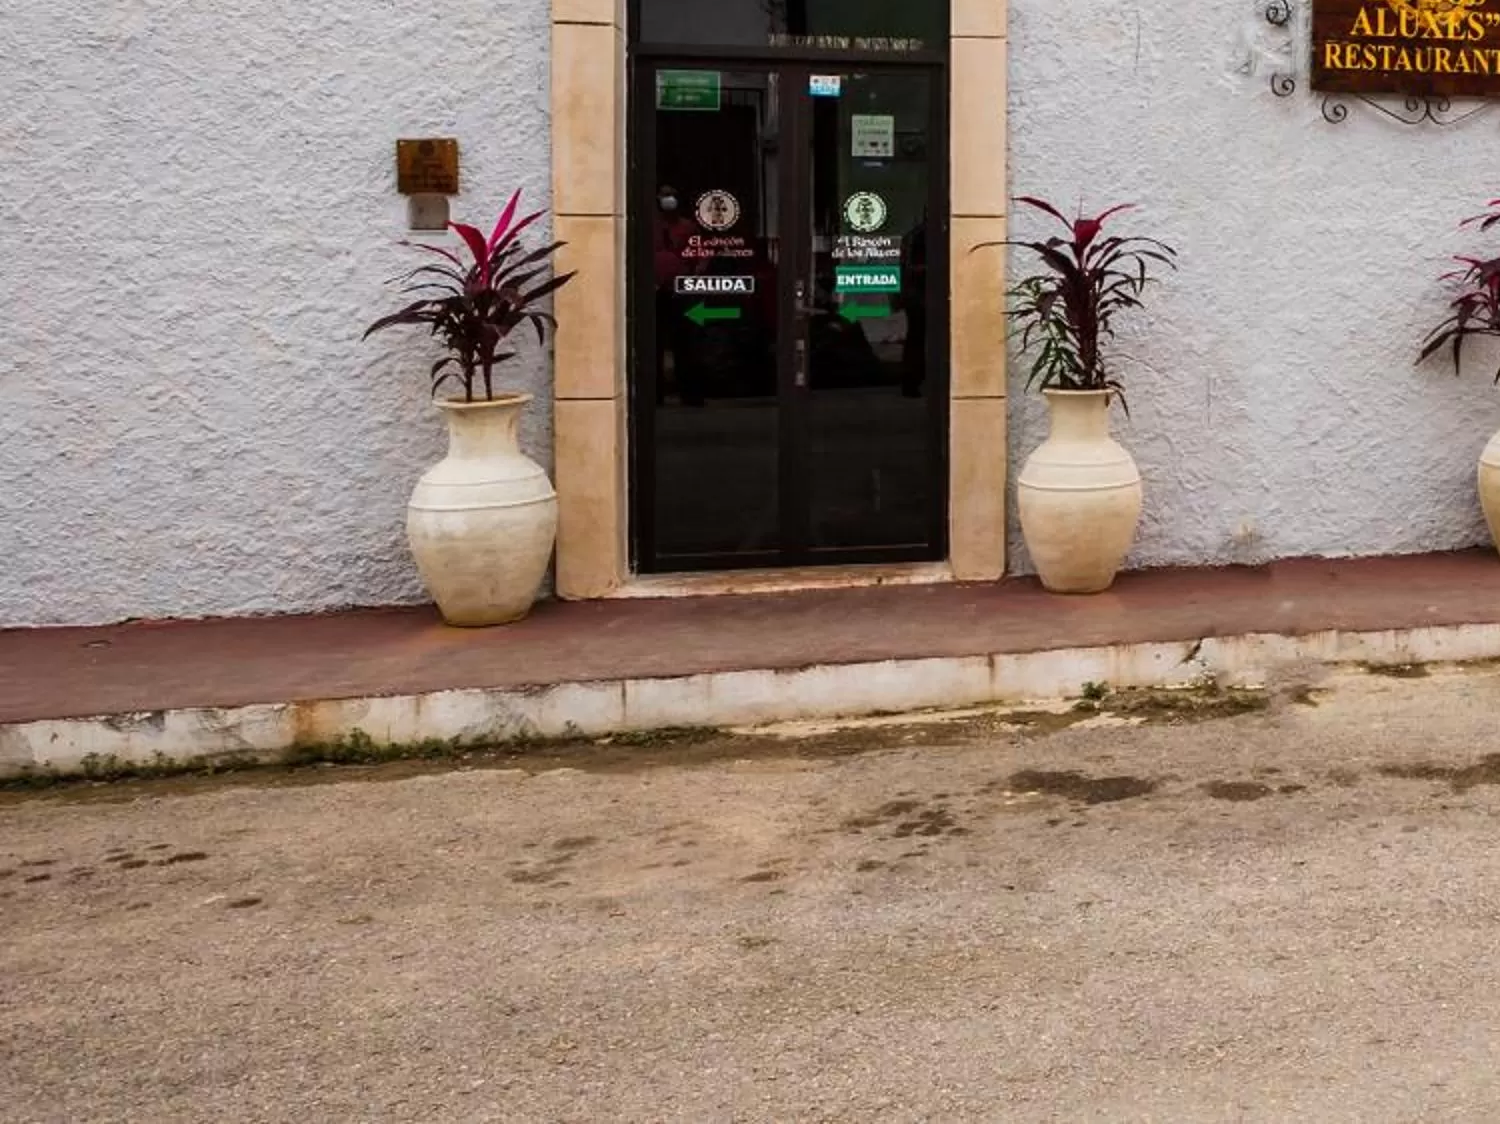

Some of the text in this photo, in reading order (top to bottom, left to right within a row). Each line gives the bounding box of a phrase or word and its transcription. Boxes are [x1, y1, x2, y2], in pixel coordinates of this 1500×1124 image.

[688, 235, 701, 247] El
[681, 246, 696, 257] de
[697, 247, 714, 257] los
[847, 247, 863, 258] los
[683, 278, 747, 291] SALIDA
[837, 274, 897, 285] ENTRADA
